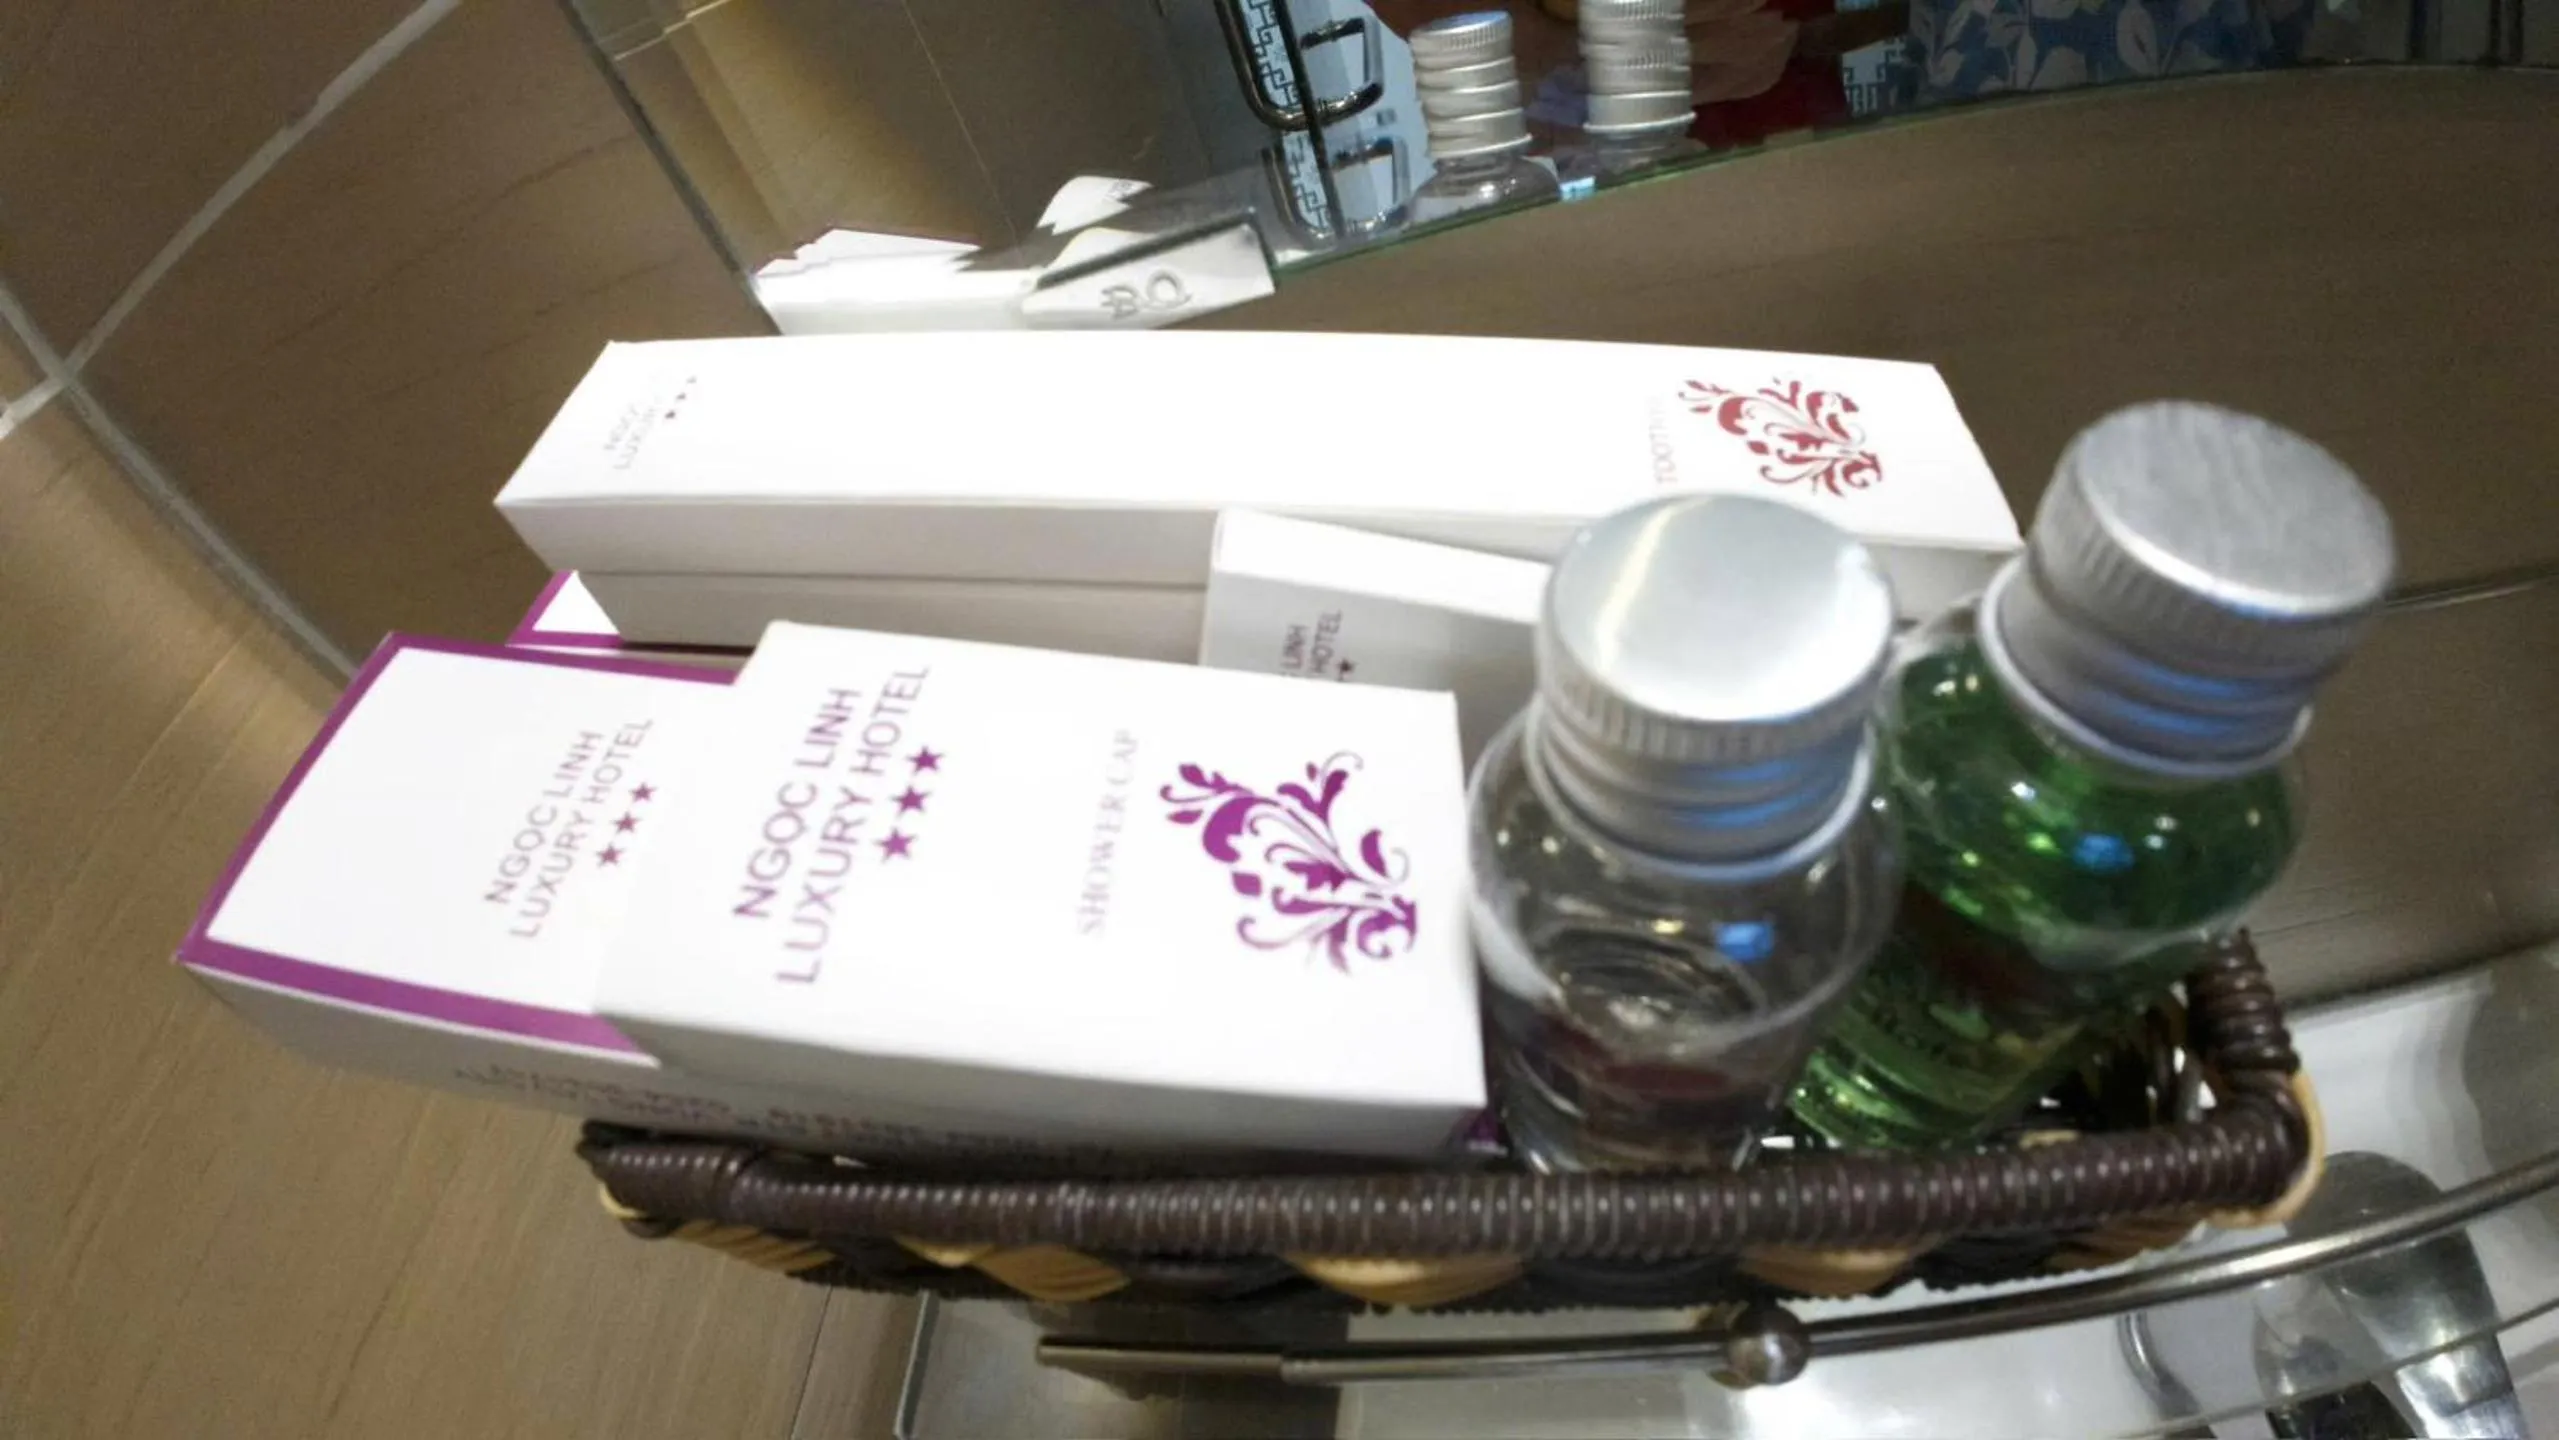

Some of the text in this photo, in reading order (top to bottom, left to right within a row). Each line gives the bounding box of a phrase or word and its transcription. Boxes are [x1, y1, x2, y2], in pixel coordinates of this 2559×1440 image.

[1309, 610, 1342, 676] HOTEL
[484, 731, 603, 905] NGOC LINH
[509, 719, 653, 938] LUXURY HOTEL
[731, 688, 861, 918] NGOC LINH
[774, 668, 929, 985] LUXURY HOTEL
[1077, 728, 1138, 937] SHOWER CAP
